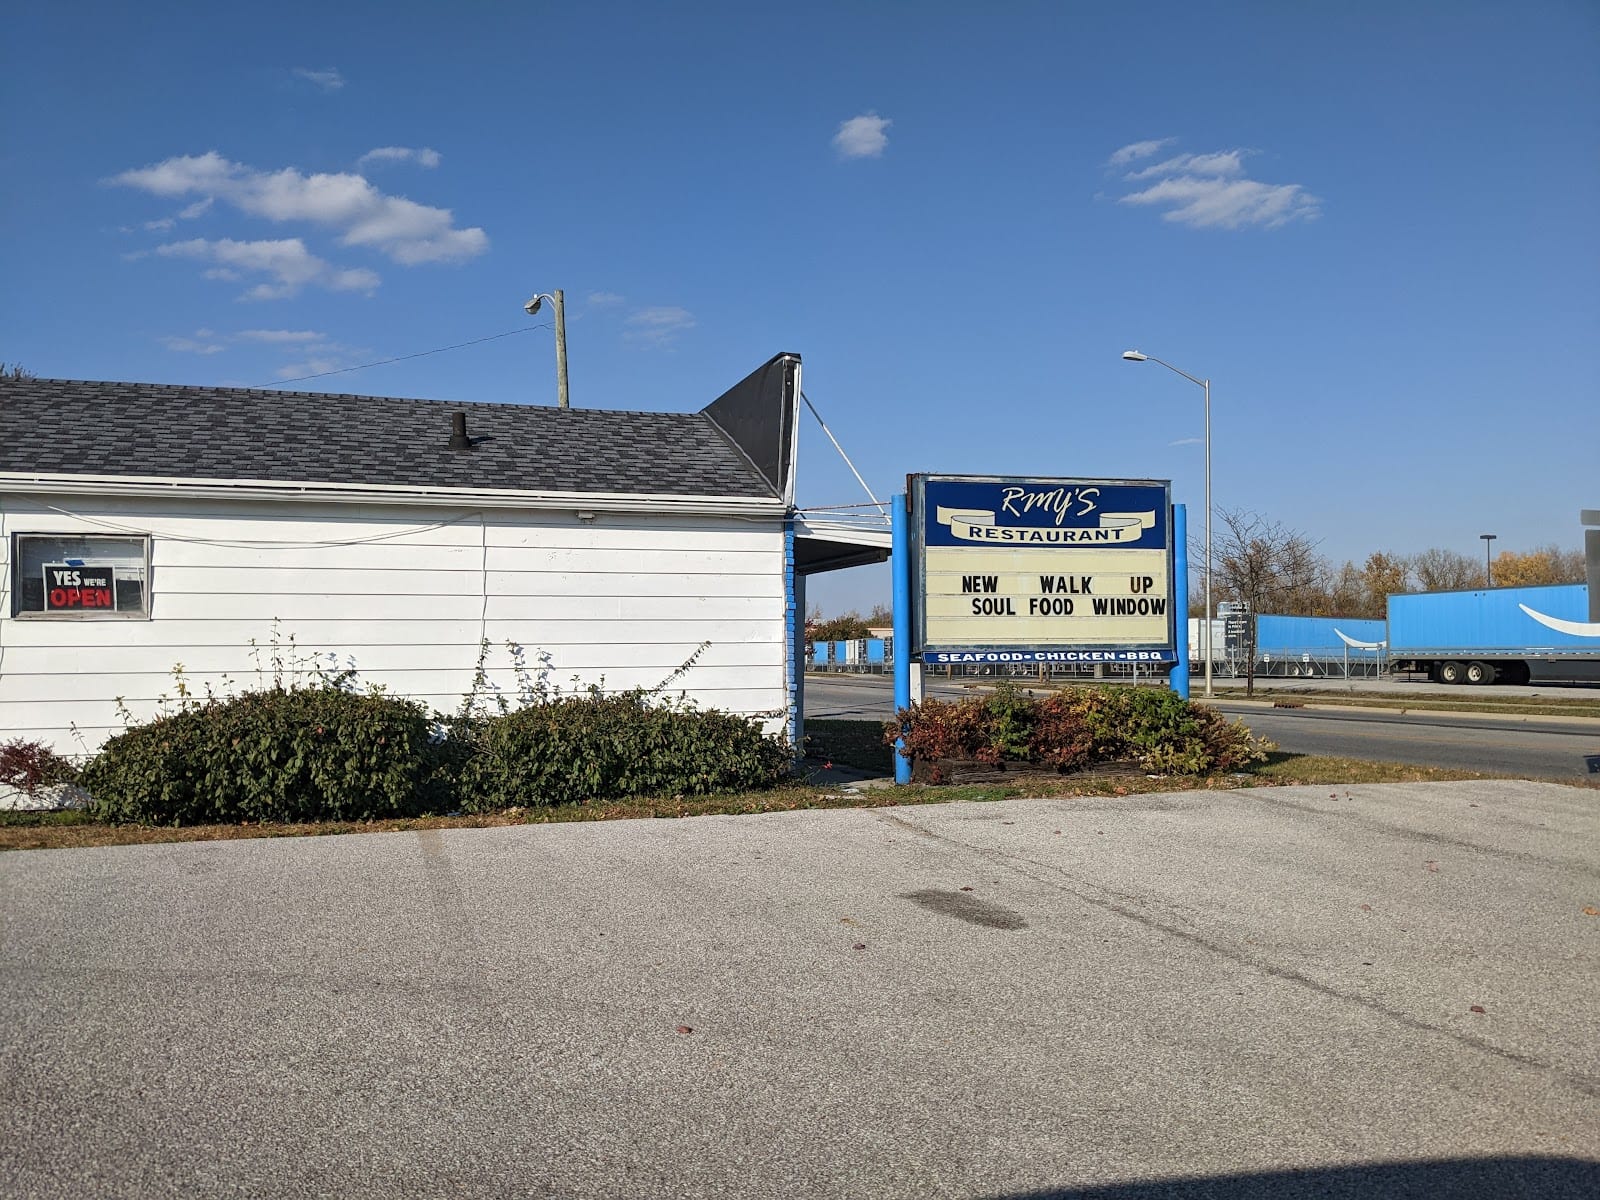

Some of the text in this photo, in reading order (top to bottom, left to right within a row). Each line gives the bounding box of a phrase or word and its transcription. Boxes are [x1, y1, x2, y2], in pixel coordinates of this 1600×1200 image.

[968, 526, 1125, 542] RESTAURANT
[53, 570, 107, 587] YES WE'RE
[962, 575, 1153, 594] NEW WALK UP
[50, 588, 112, 607] OPEN
[972, 597, 1166, 616] SOUL FOOD WINDOW
